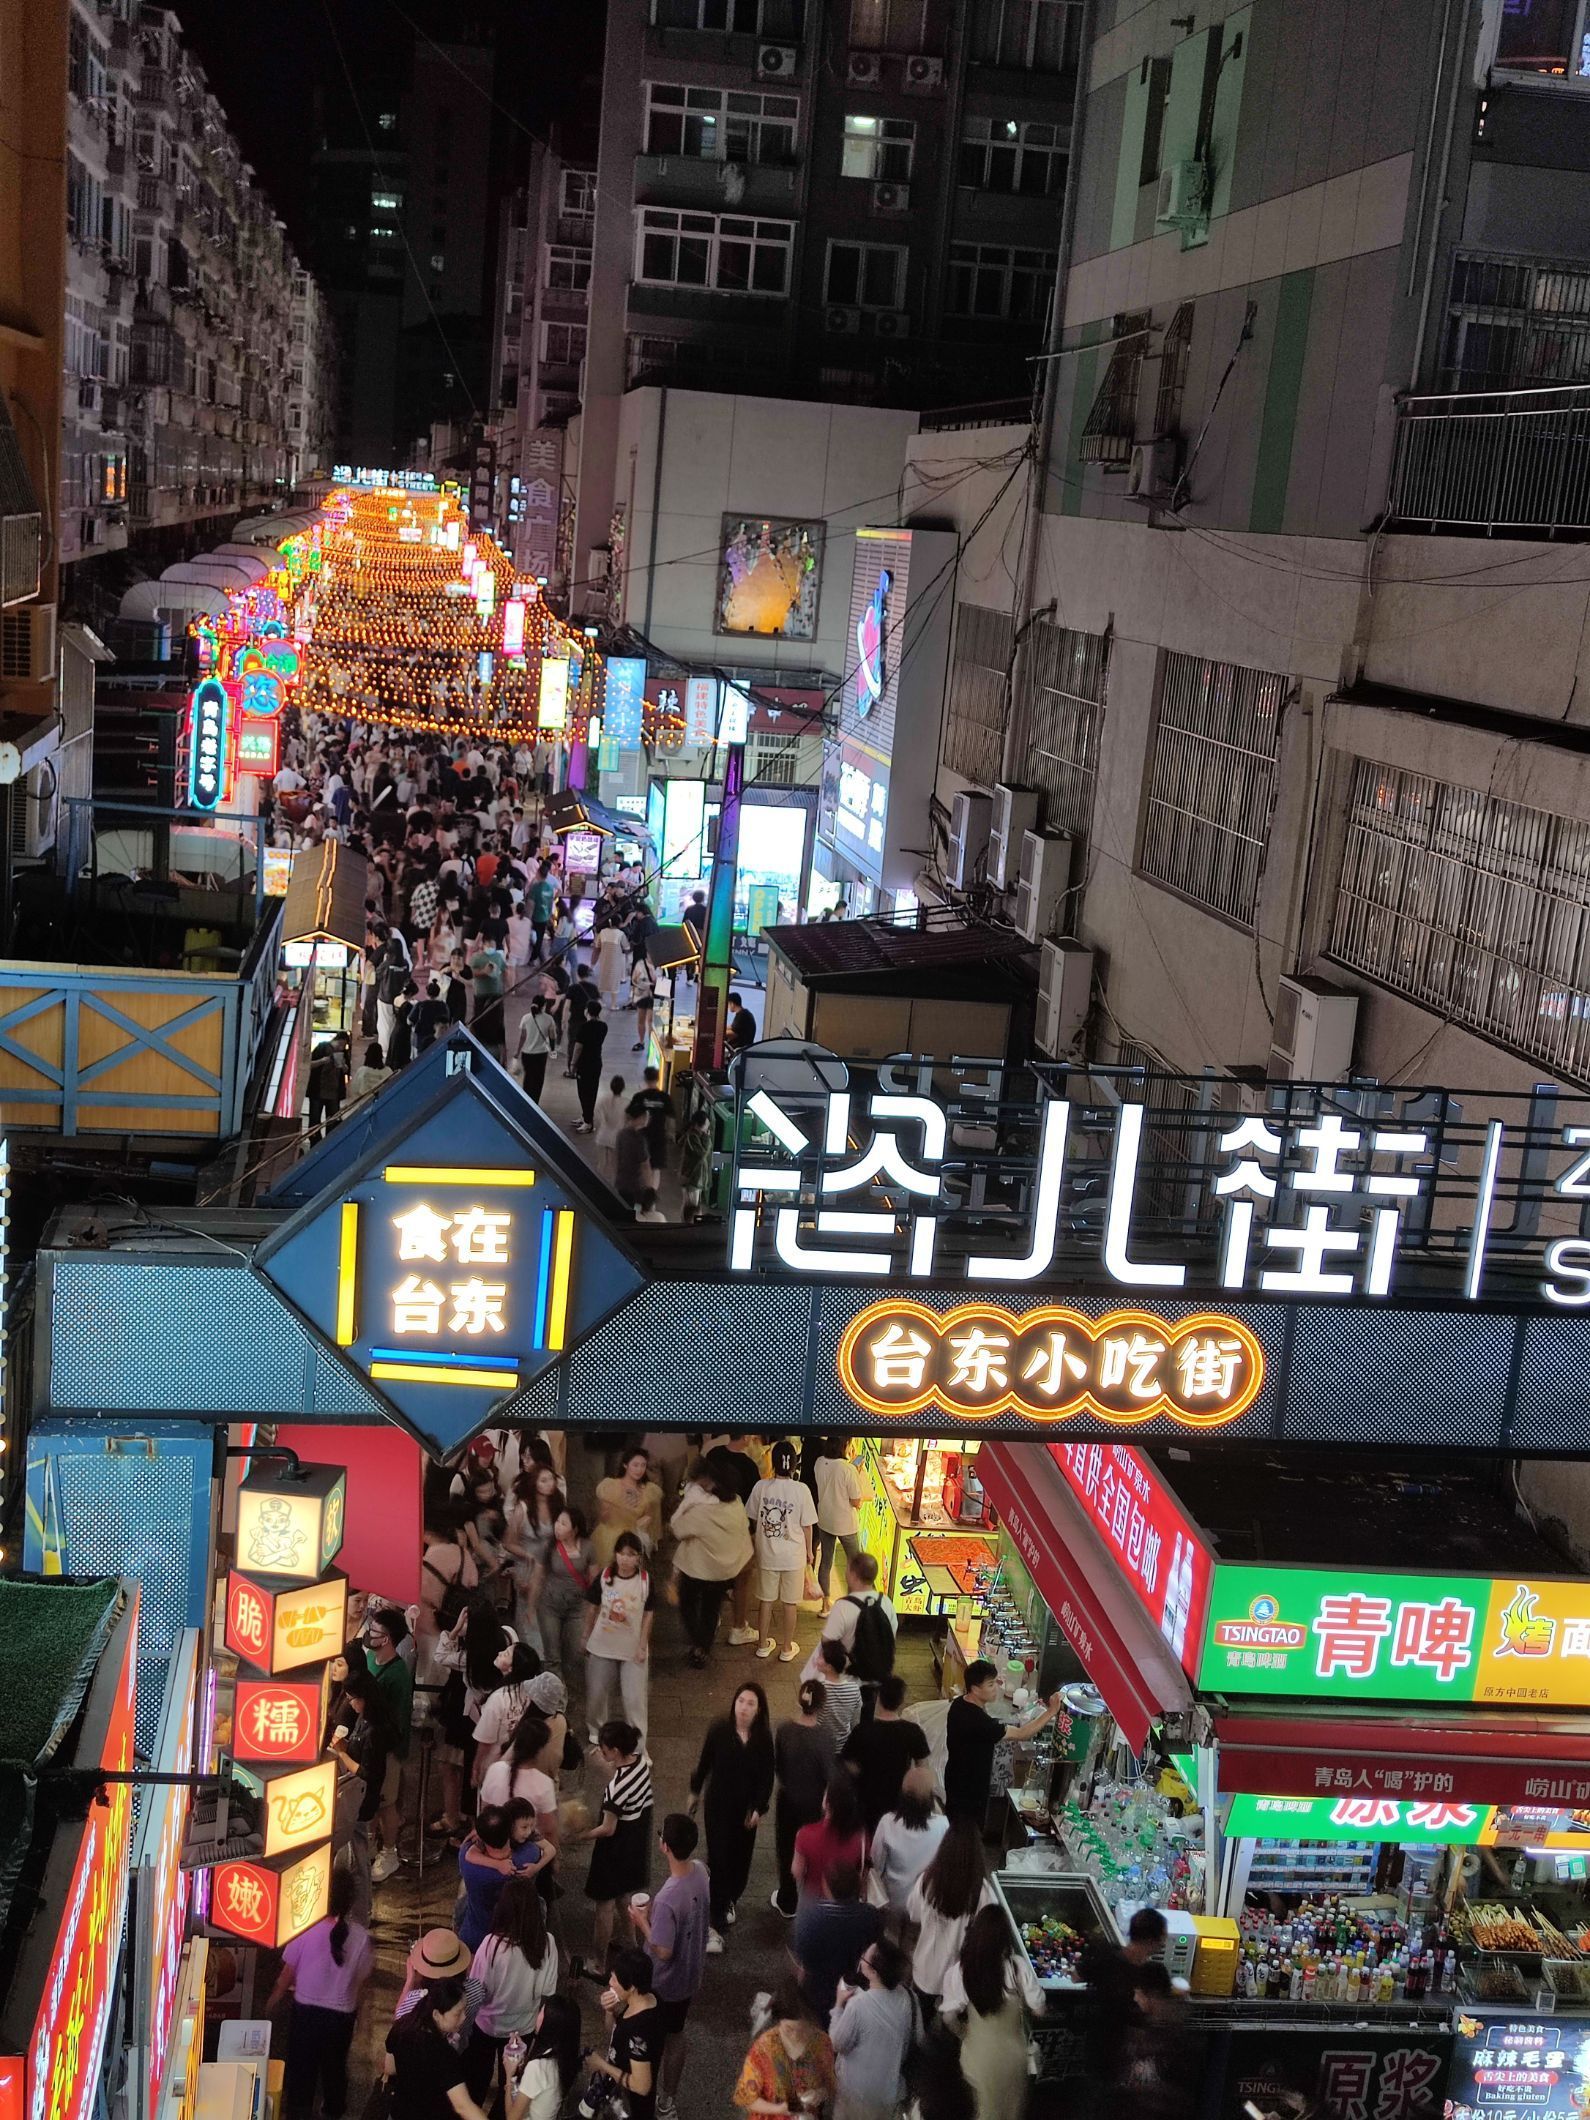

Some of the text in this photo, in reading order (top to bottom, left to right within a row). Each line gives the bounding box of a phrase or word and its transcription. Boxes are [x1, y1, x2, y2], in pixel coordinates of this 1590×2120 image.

[523, 440, 557, 577] 美食广场
[392, 1203, 512, 1264] 食在
[391, 1274, 507, 1335] 台东
[869, 1322, 1243, 1399] 台东小吃街
[235, 1590, 263, 1648] 脆
[1221, 1624, 1300, 1644] TSINGTAO
[1313, 1595, 1475, 1681] 青啤
[251, 1698, 301, 1745] 糯
[226, 1871, 263, 1924] 嫩
[1320, 2049, 1442, 2120] 原浆
[1471, 2049, 1565, 2069] 麻辣毛蛋
[1483, 2071, 1550, 2083] 舌尖上的美食
[1485, 2092, 1546, 2102] Baking gluten
